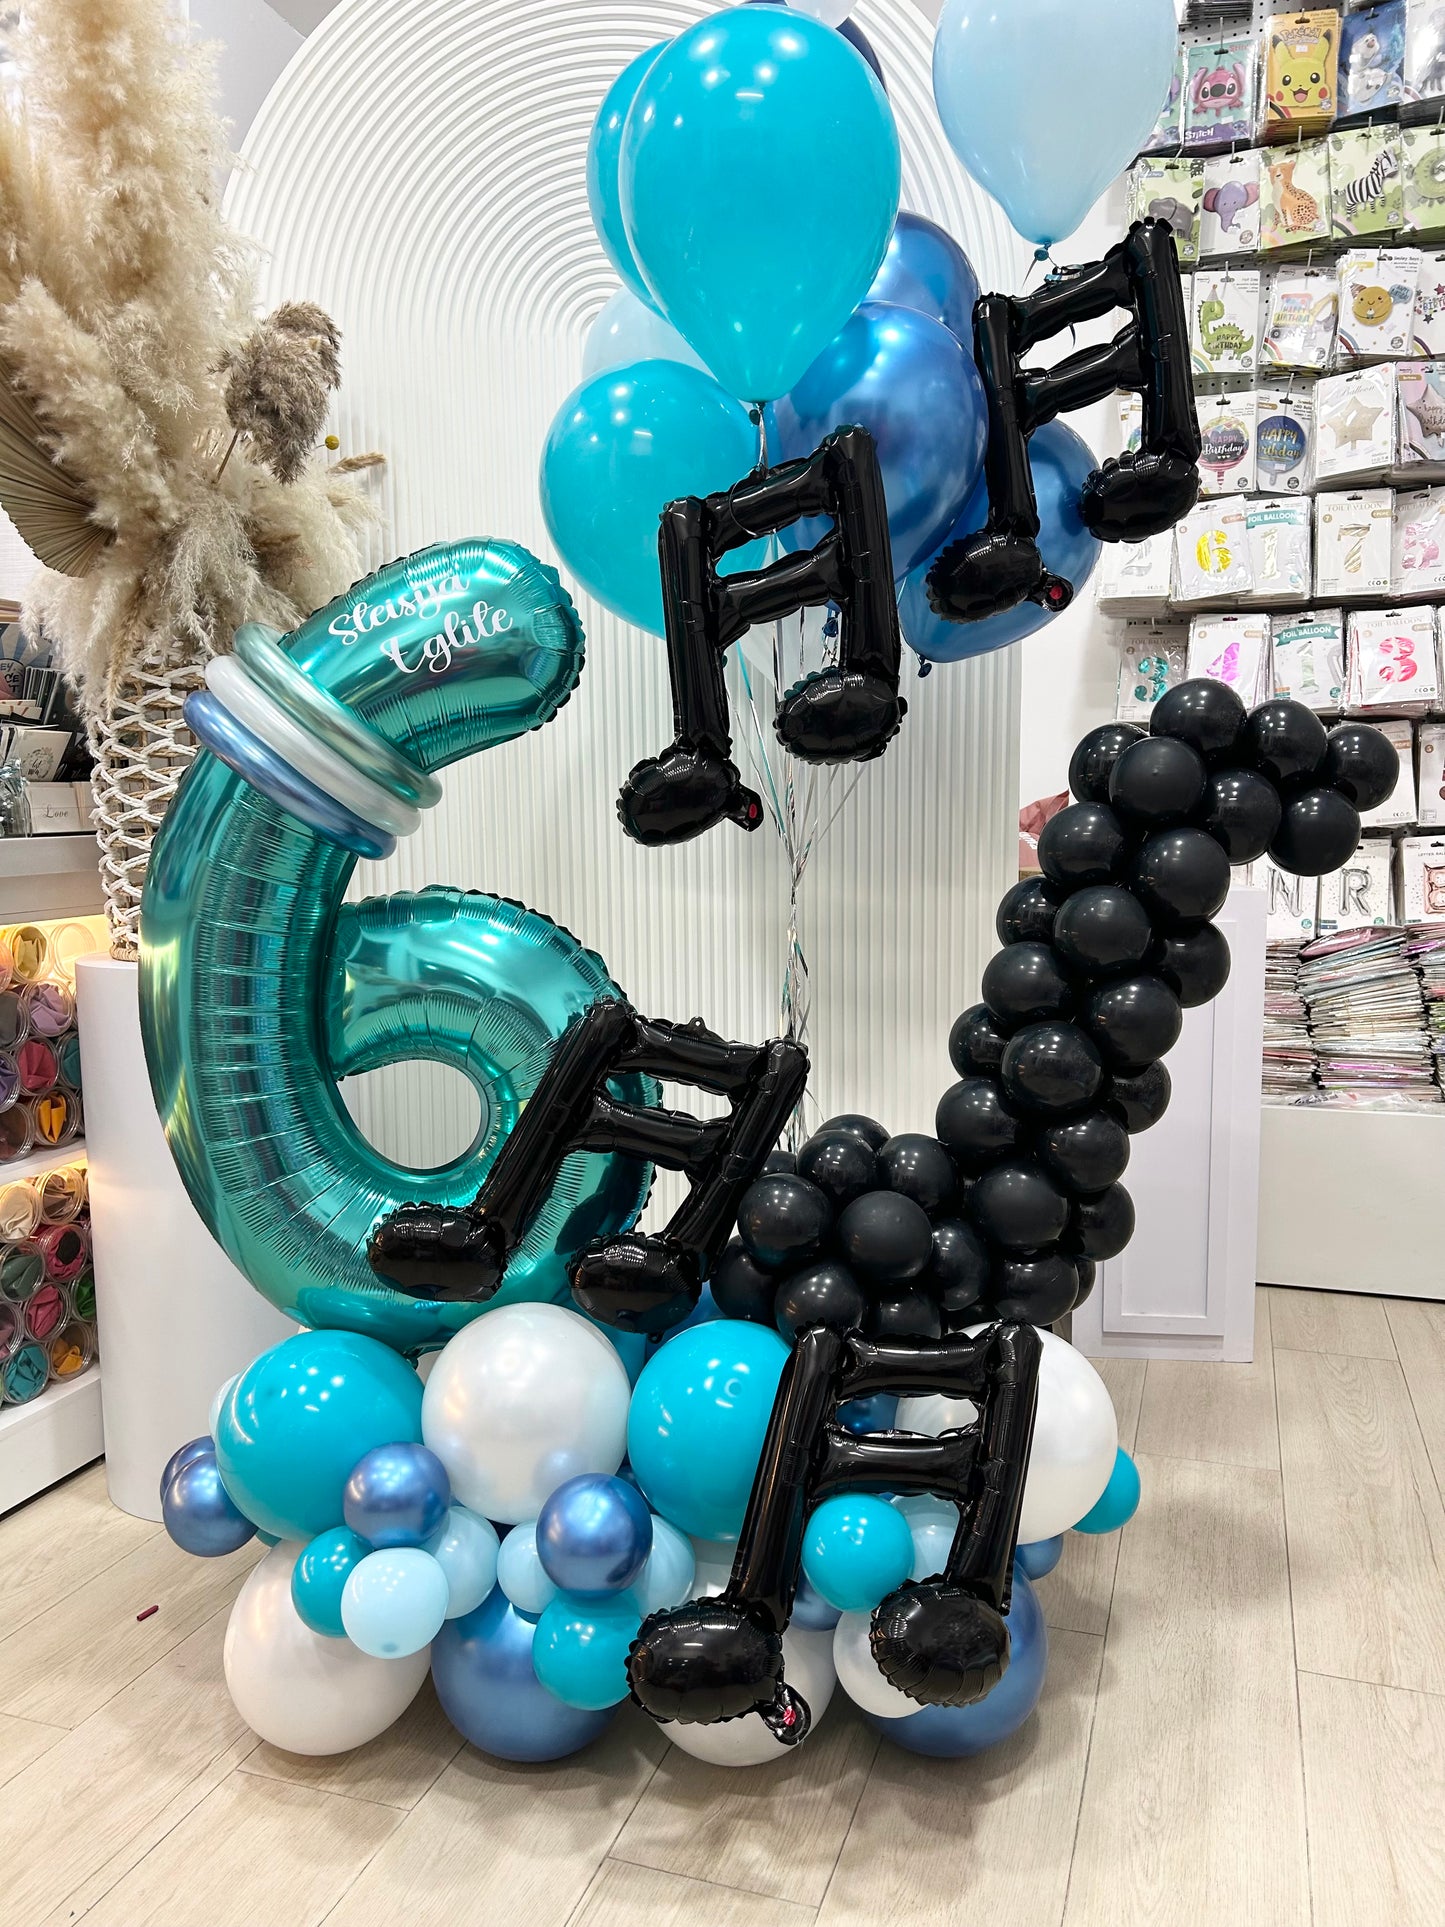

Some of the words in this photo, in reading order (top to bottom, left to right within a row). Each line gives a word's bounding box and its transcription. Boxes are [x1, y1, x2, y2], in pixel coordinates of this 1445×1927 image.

[1202, 442, 1243, 456] Birthday
[1264, 513, 1296, 522] BALLOON
[1283, 631, 1298, 639] FOIL
[1299, 627, 1332, 637] BALLOON
[43, 804, 69, 818] Love
